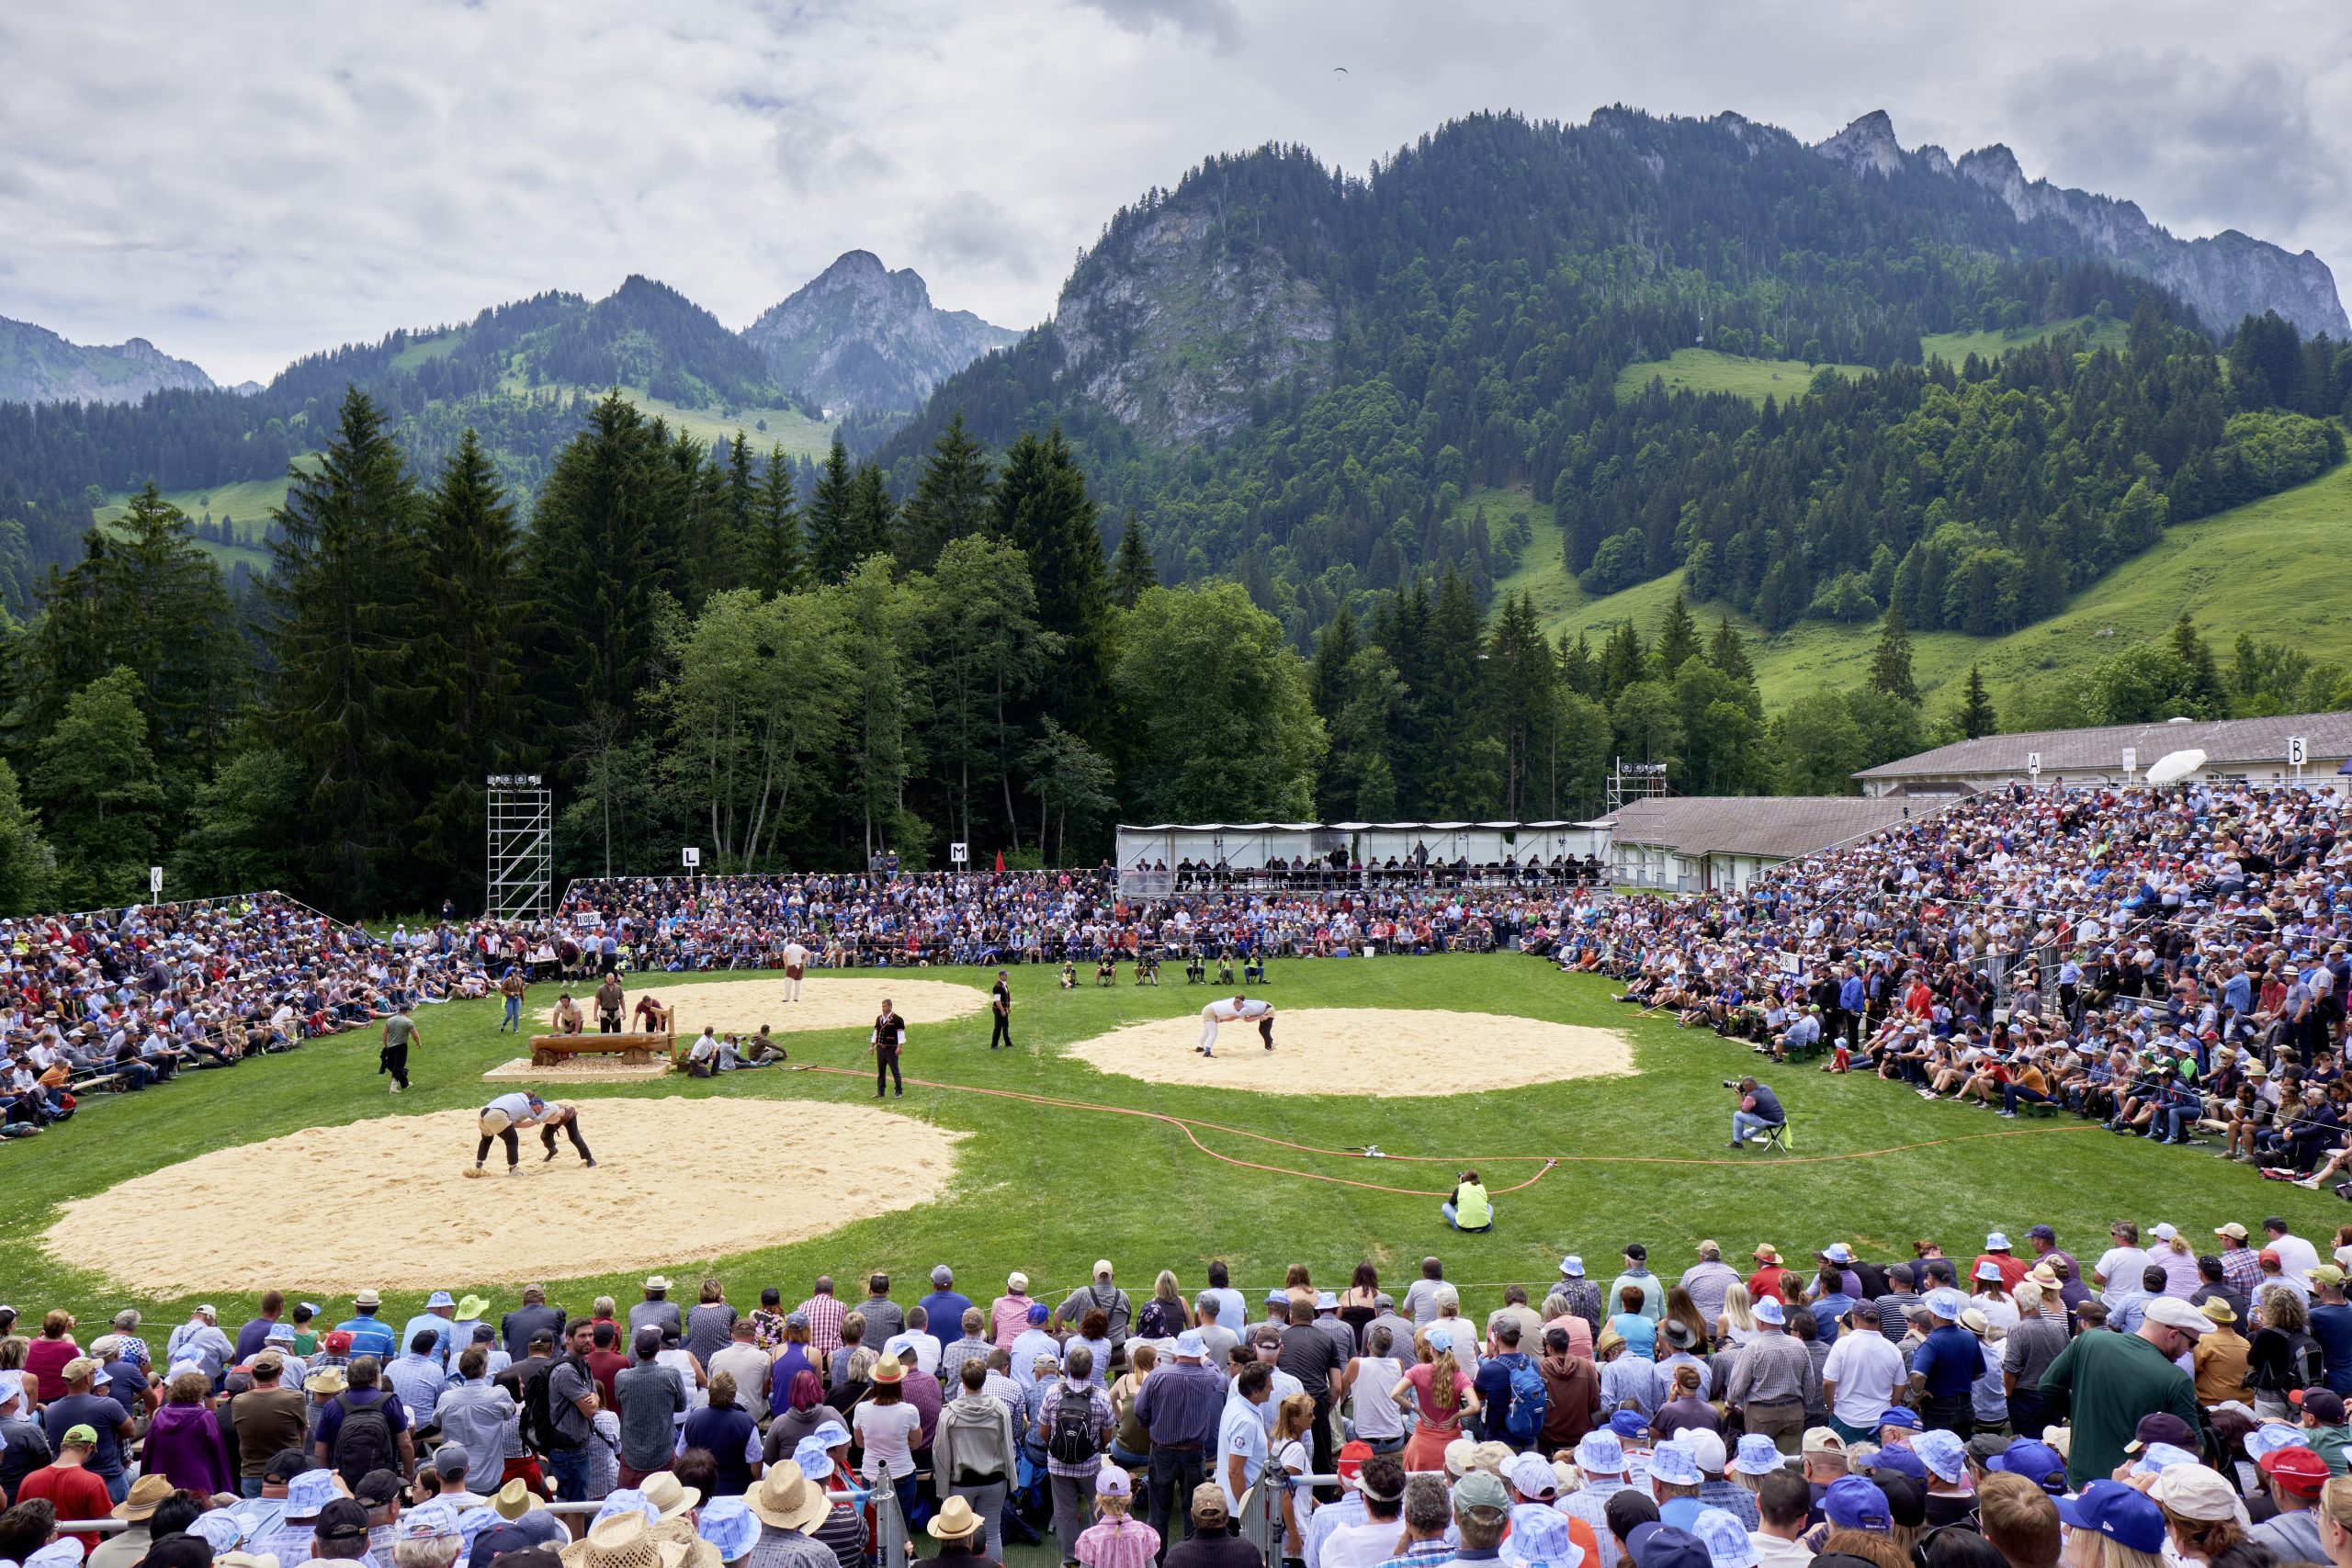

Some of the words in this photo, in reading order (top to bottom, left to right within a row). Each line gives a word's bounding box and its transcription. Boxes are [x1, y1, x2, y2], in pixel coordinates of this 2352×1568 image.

[2293, 740, 2302, 762] B
[2030, 755, 2039, 772] A
[685, 851, 696, 863] L
[953, 846, 966, 859] M
[153, 869, 160, 889] K
[580, 915, 594, 924] 102
